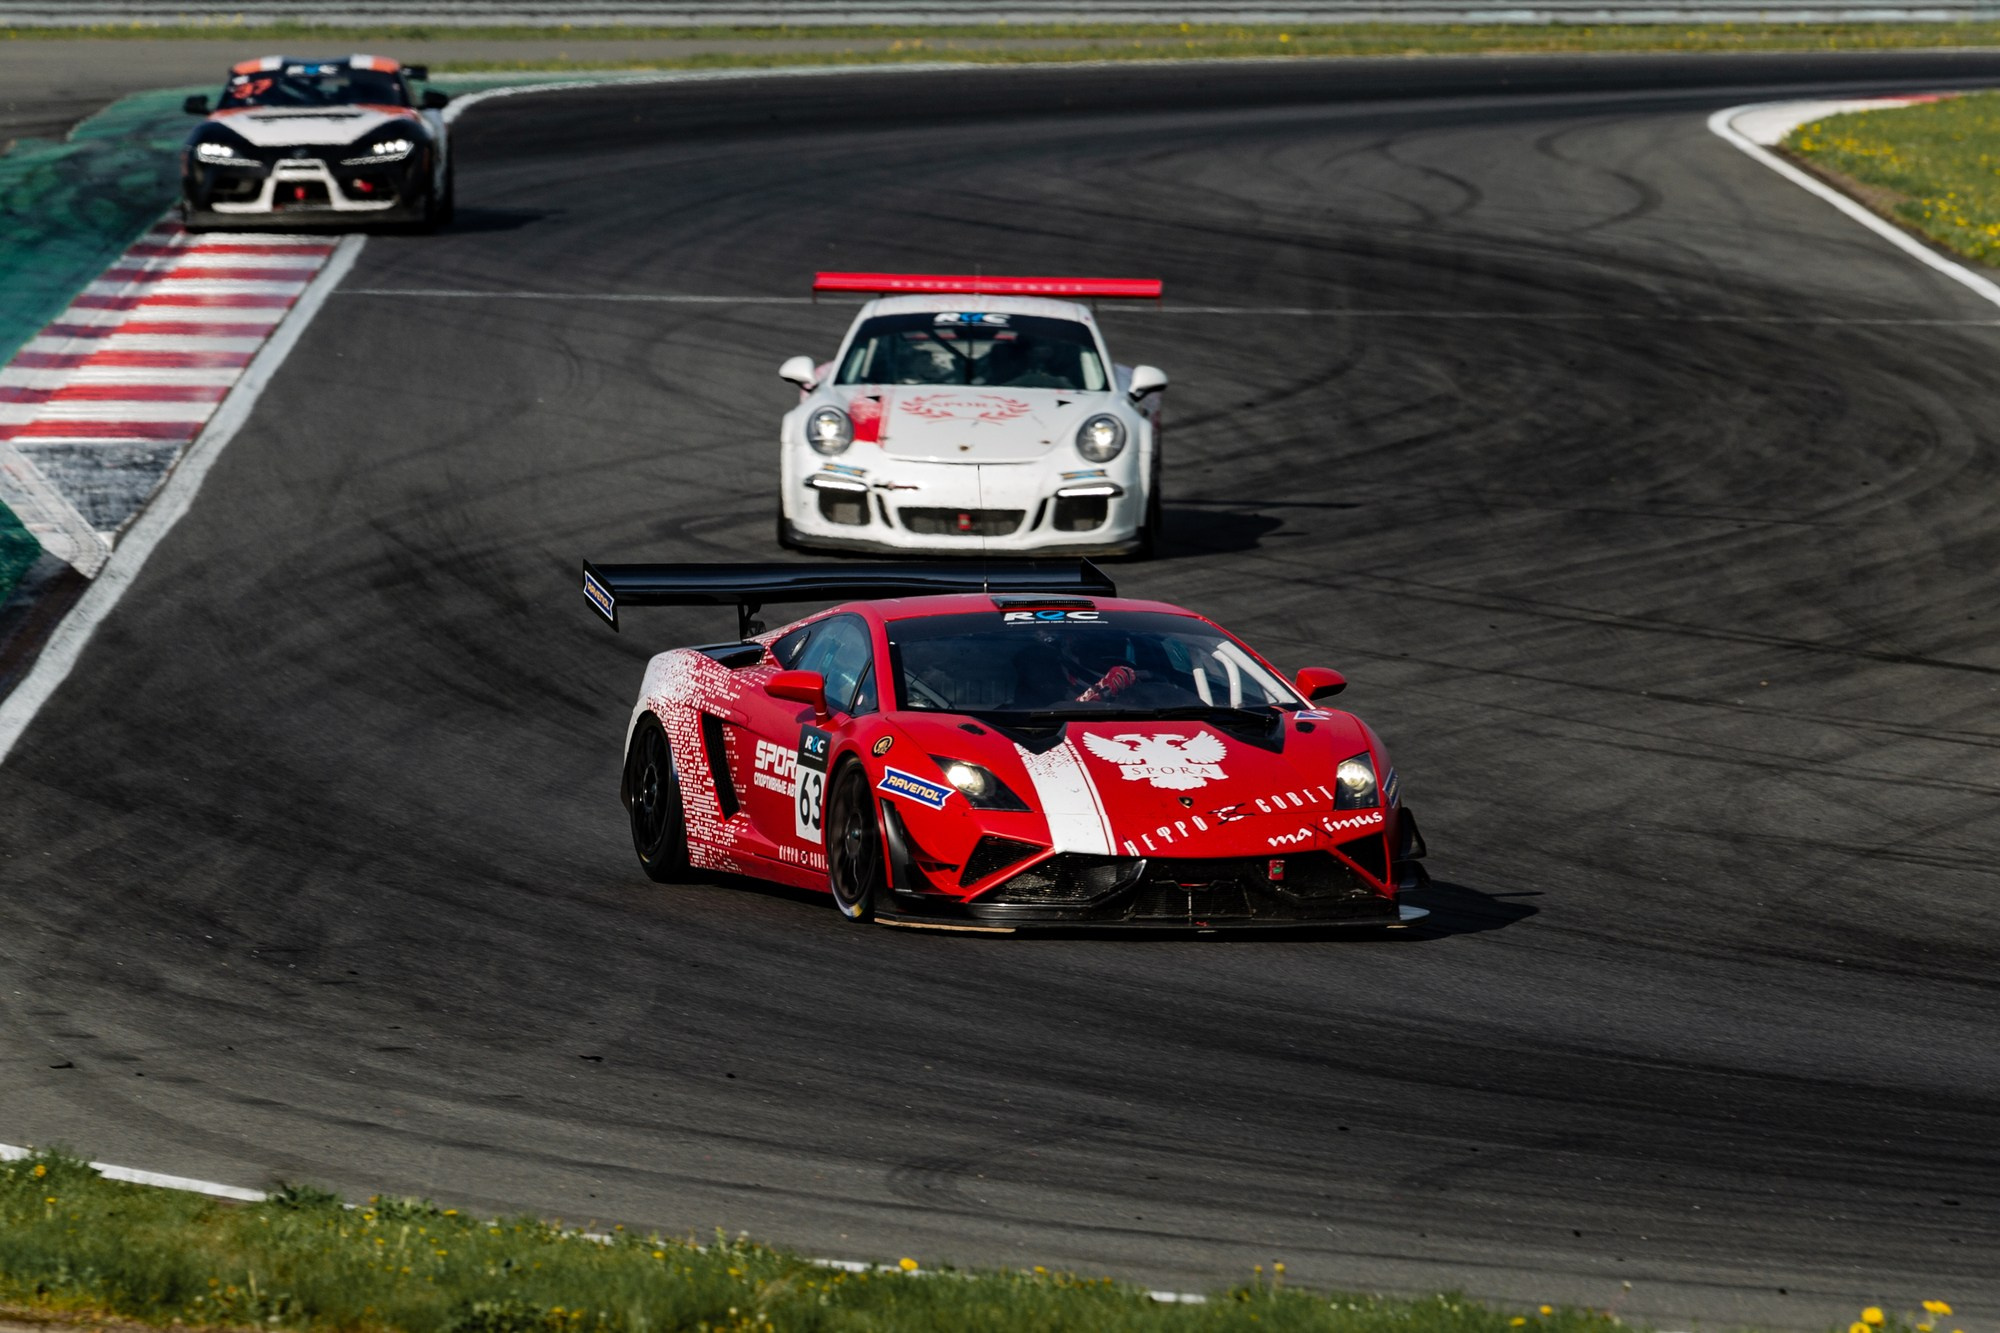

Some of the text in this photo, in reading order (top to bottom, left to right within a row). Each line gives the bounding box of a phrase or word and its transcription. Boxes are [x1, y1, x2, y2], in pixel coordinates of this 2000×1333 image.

[754, 739, 798, 780] SPOR
[1130, 765, 1212, 776] SPORA
[799, 771, 822, 831] 63
[886, 775, 941, 802] RAVENOL
